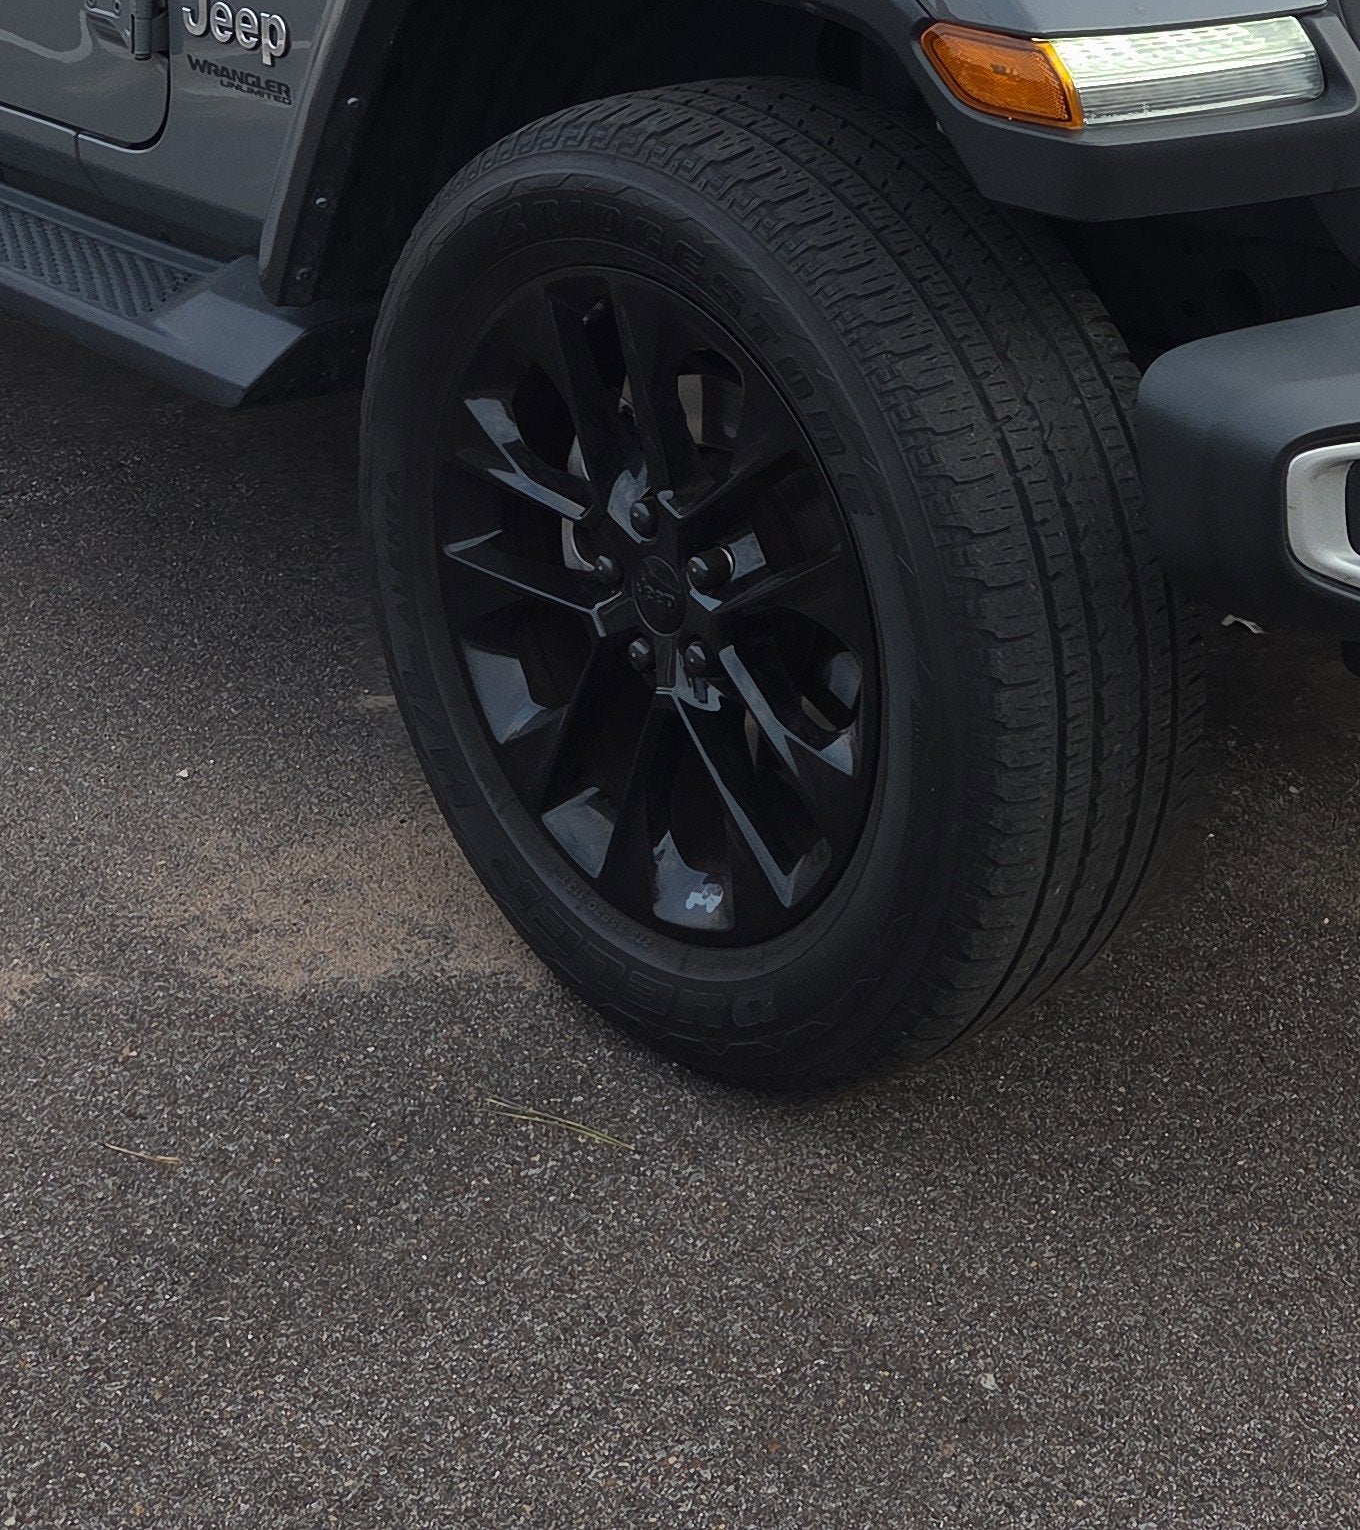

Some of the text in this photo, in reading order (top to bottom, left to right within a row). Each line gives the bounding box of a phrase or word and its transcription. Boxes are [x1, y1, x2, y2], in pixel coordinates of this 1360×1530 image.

[186, 53, 291, 96] WRANGLER
[219, 79, 292, 106] UNLIMITED
[492, 199, 875, 518] BRIDGESTONE
